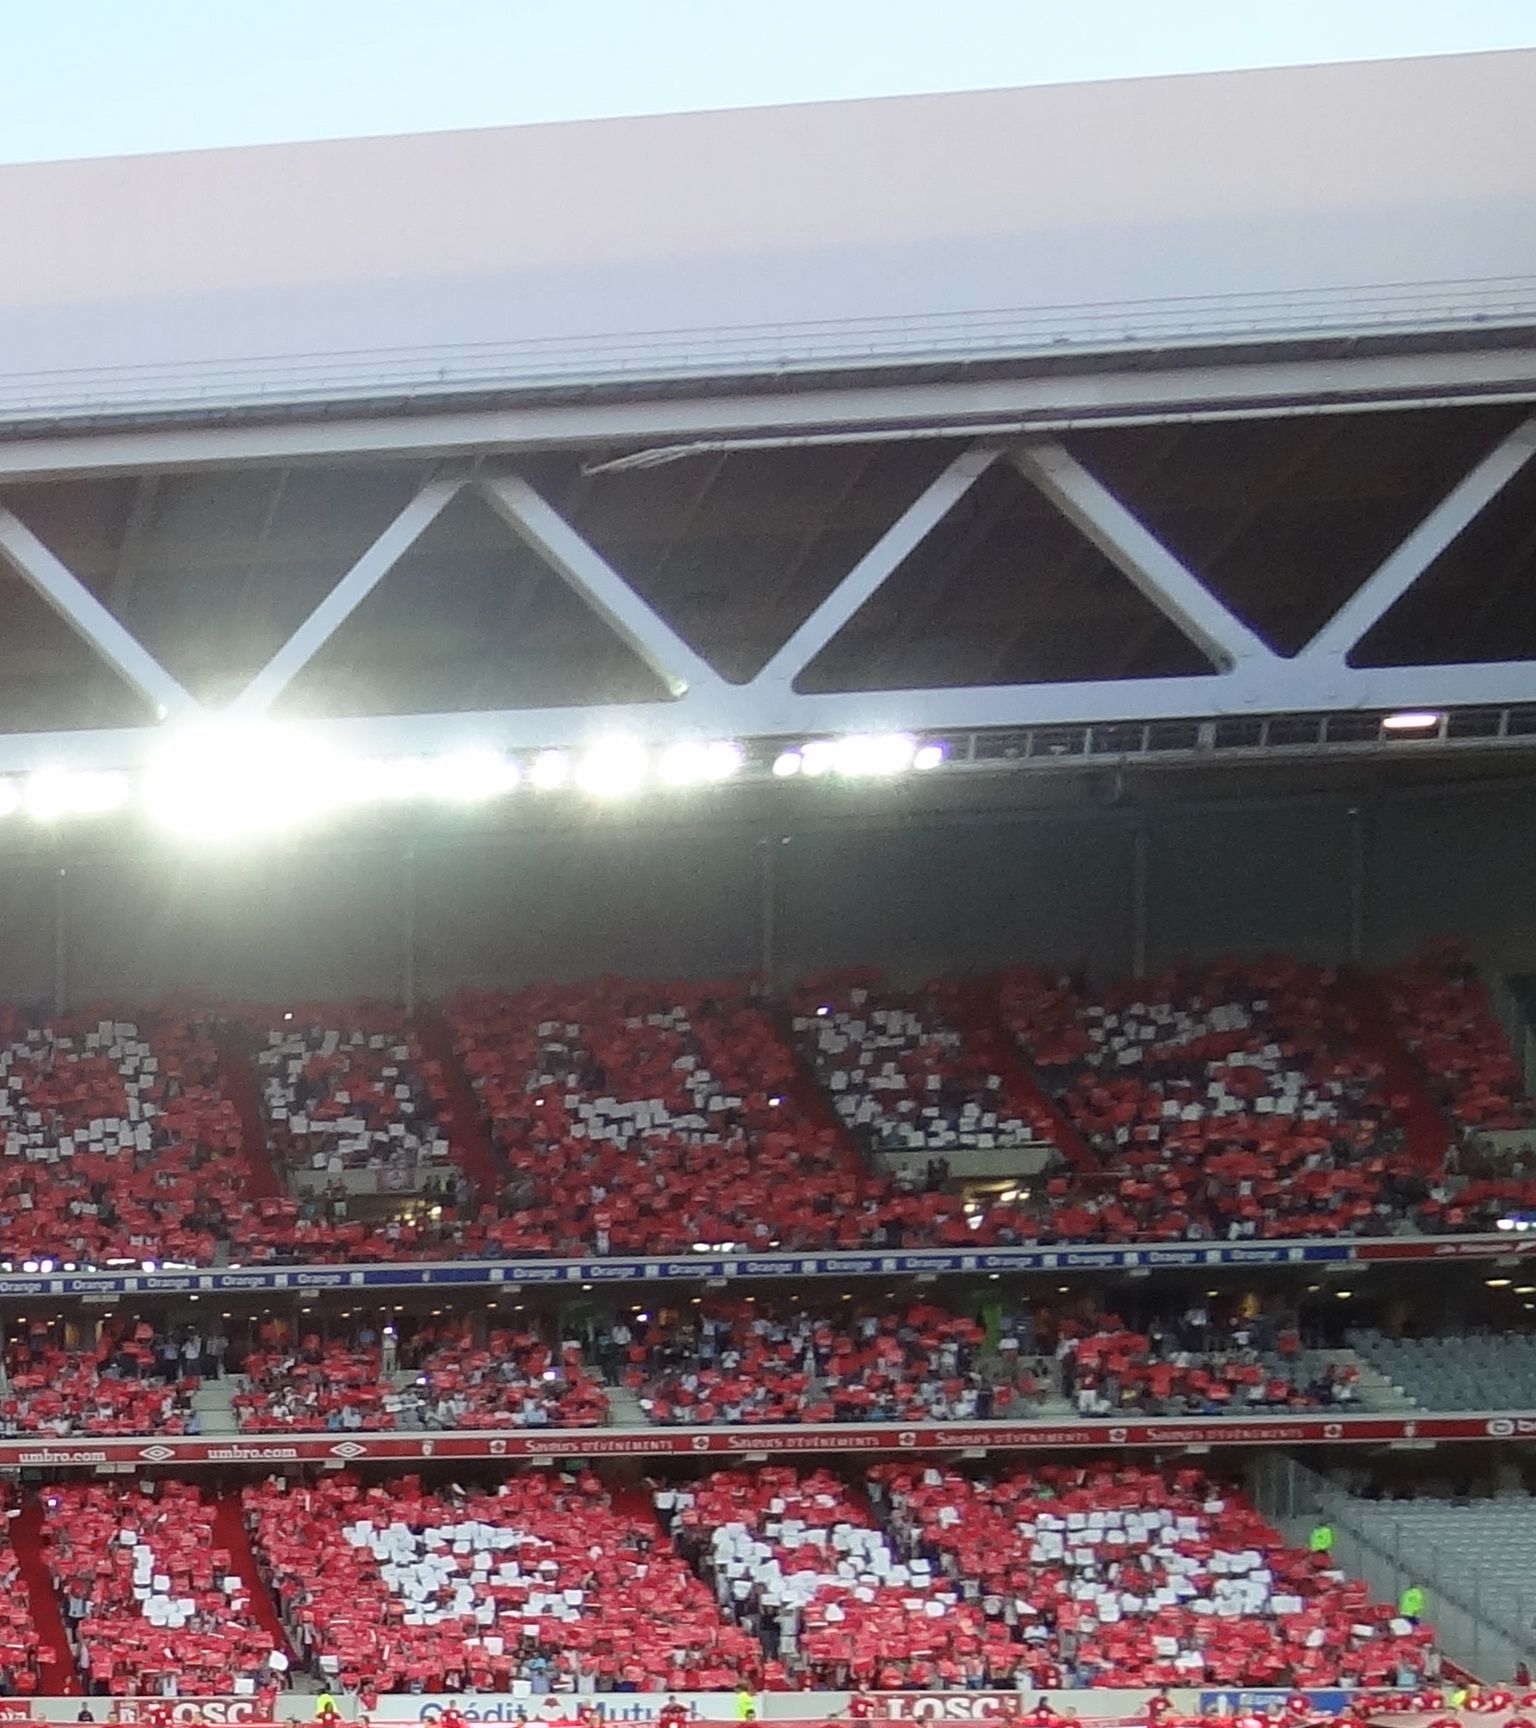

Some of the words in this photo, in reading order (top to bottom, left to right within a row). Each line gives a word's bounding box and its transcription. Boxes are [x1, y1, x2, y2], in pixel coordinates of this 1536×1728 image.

[668, 1263, 713, 1276] Orange
[747, 1261, 793, 1273] Orange
[827, 1259, 873, 1271] Orange
[906, 1257, 952, 1270] Orange
[513, 1267, 558, 1280] Orange
[590, 1265, 636, 1278] Orange
[72, 1278, 115, 1291] Orange
[147, 1276, 190, 1289] Orange
[222, 1275, 266, 1287] Orange
[297, 1273, 341, 1285] Orange
[0, 1280, 41, 1293] Orange
[19, 1449, 106, 1463] umbro.com
[208, 1445, 297, 1459] umbro.com
[164, 1701, 253, 1723] OSC
